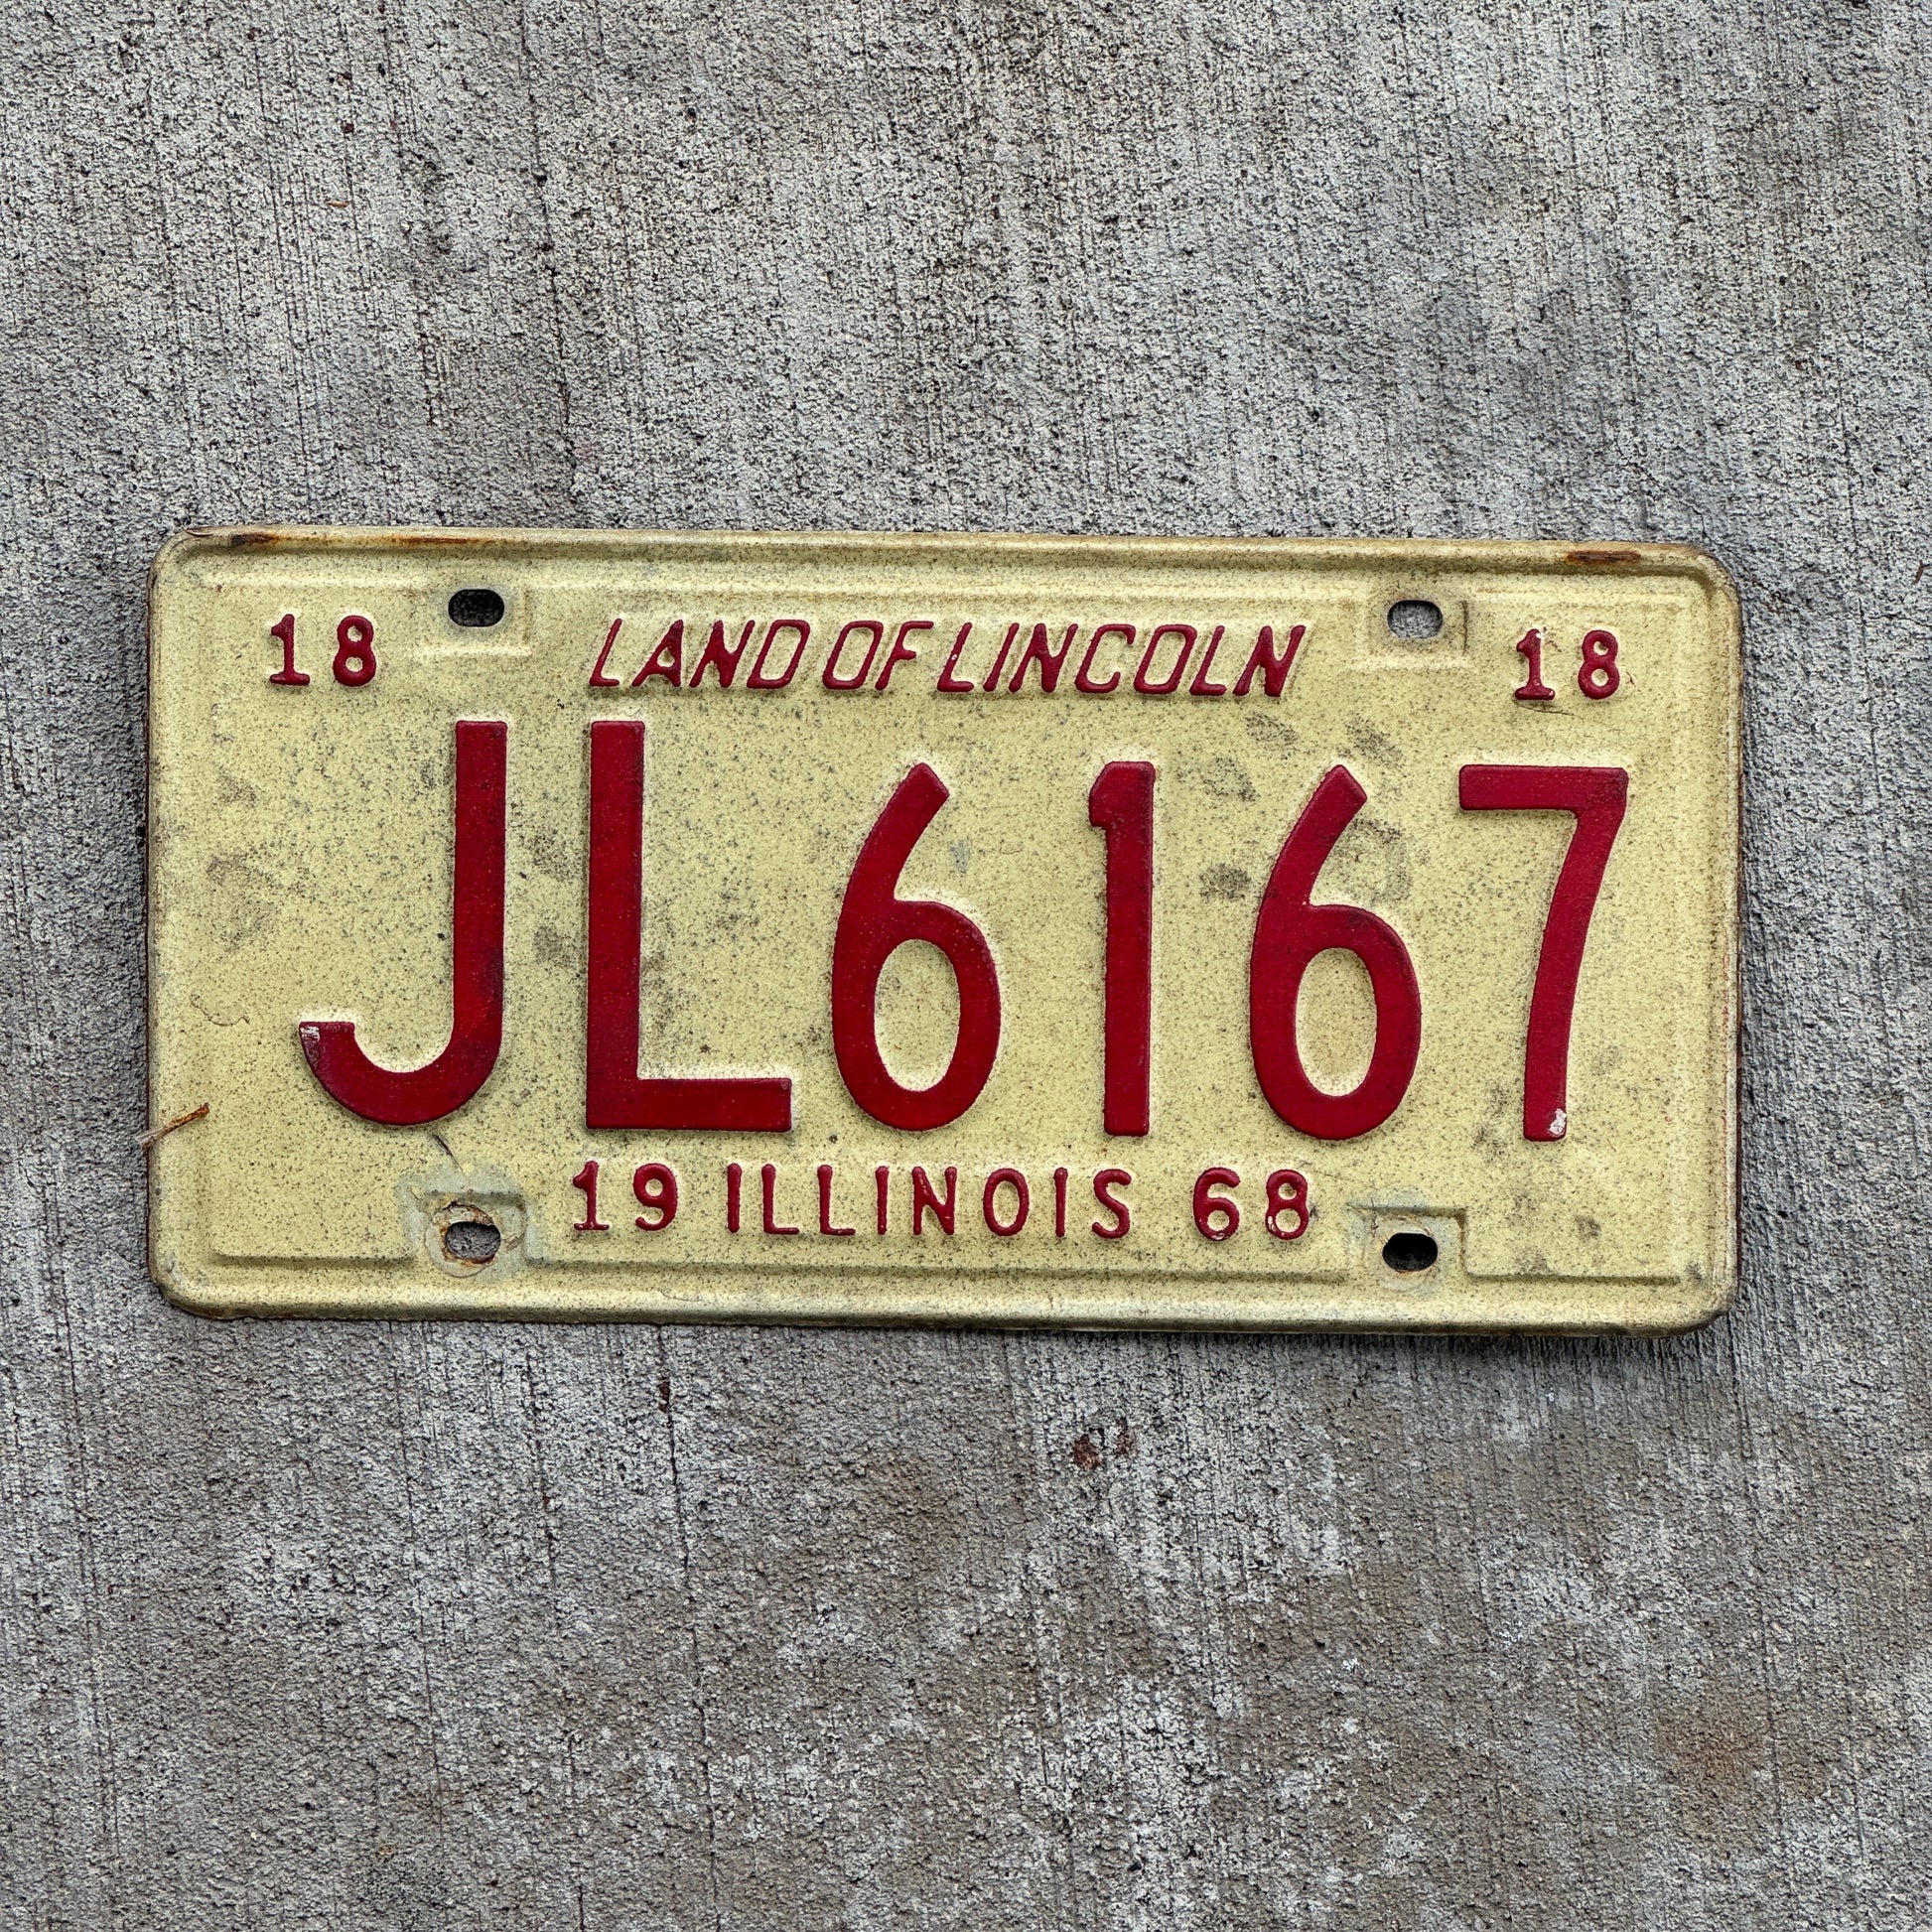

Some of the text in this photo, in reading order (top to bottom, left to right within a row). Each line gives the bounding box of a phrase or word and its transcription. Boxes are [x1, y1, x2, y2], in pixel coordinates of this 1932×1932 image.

[270, 614, 378, 688] 18
[589, 618, 1307, 698] LAND OF LINCOLN
[1514, 627, 1621, 702] 18
[572, 1159, 1311, 1242] 19 ILLINOIS 68
